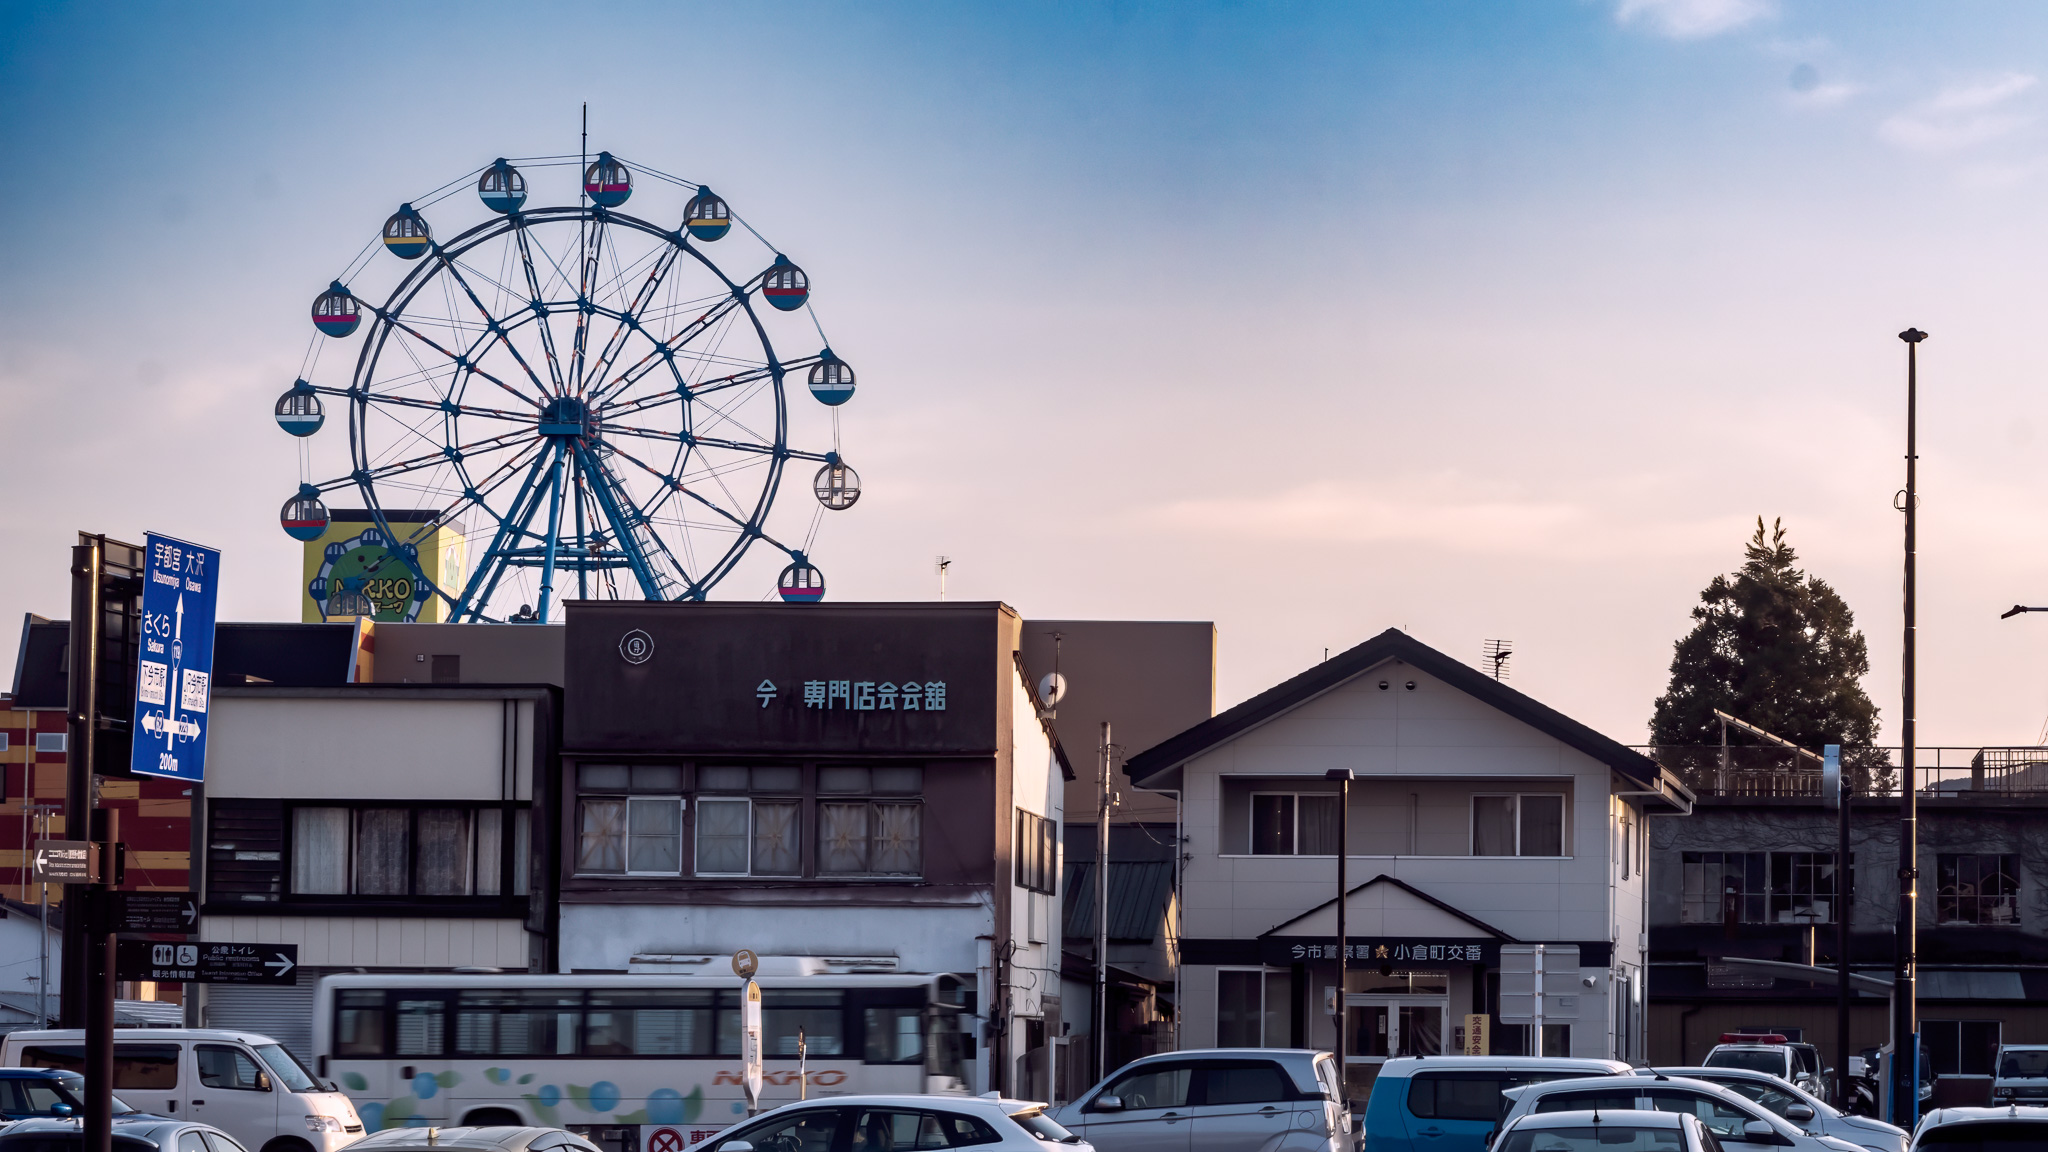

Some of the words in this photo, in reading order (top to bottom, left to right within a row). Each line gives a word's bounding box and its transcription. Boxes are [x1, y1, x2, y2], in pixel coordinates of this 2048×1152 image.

[154, 543, 182, 572] 宇都宮
[185, 550, 205, 577] 大沢
[185, 576, 202, 593] Osawa
[332, 578, 411, 600] NKKO
[144, 610, 170, 638] さくら
[756, 679, 778, 708] 今
[159, 752, 179, 772] 200m
[202, 953, 224, 961] Public
[1394, 943, 1482, 961] 小倉町交番
[152, 969, 196, 979] 観光情報館
[1472, 1015, 1482, 1056] 交通安全
[712, 1070, 848, 1086] NKKO
